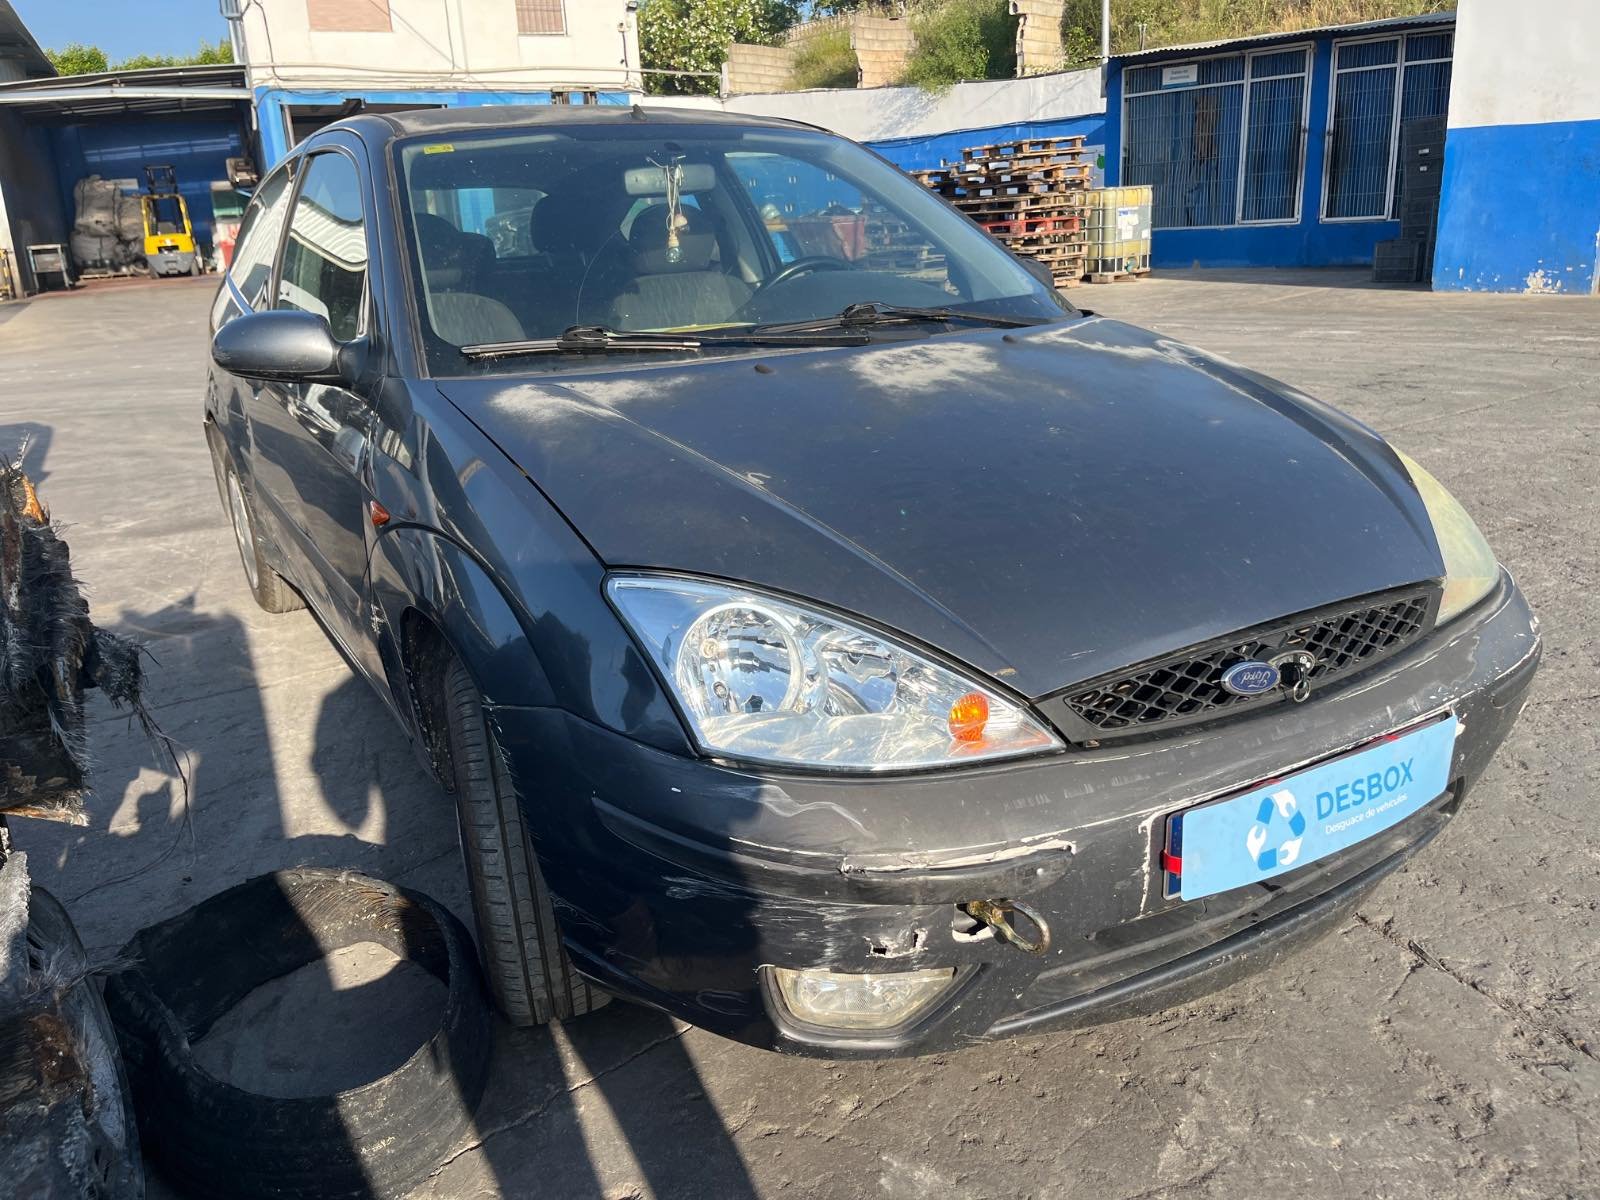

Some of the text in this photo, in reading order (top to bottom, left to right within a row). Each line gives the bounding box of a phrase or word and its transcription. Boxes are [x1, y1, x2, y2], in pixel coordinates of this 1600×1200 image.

[1240, 670, 1271, 688] Ford
[1316, 757, 1414, 820] DESBOX
[1325, 813, 1364, 834] Desguace
[1365, 807, 1376, 818] de
